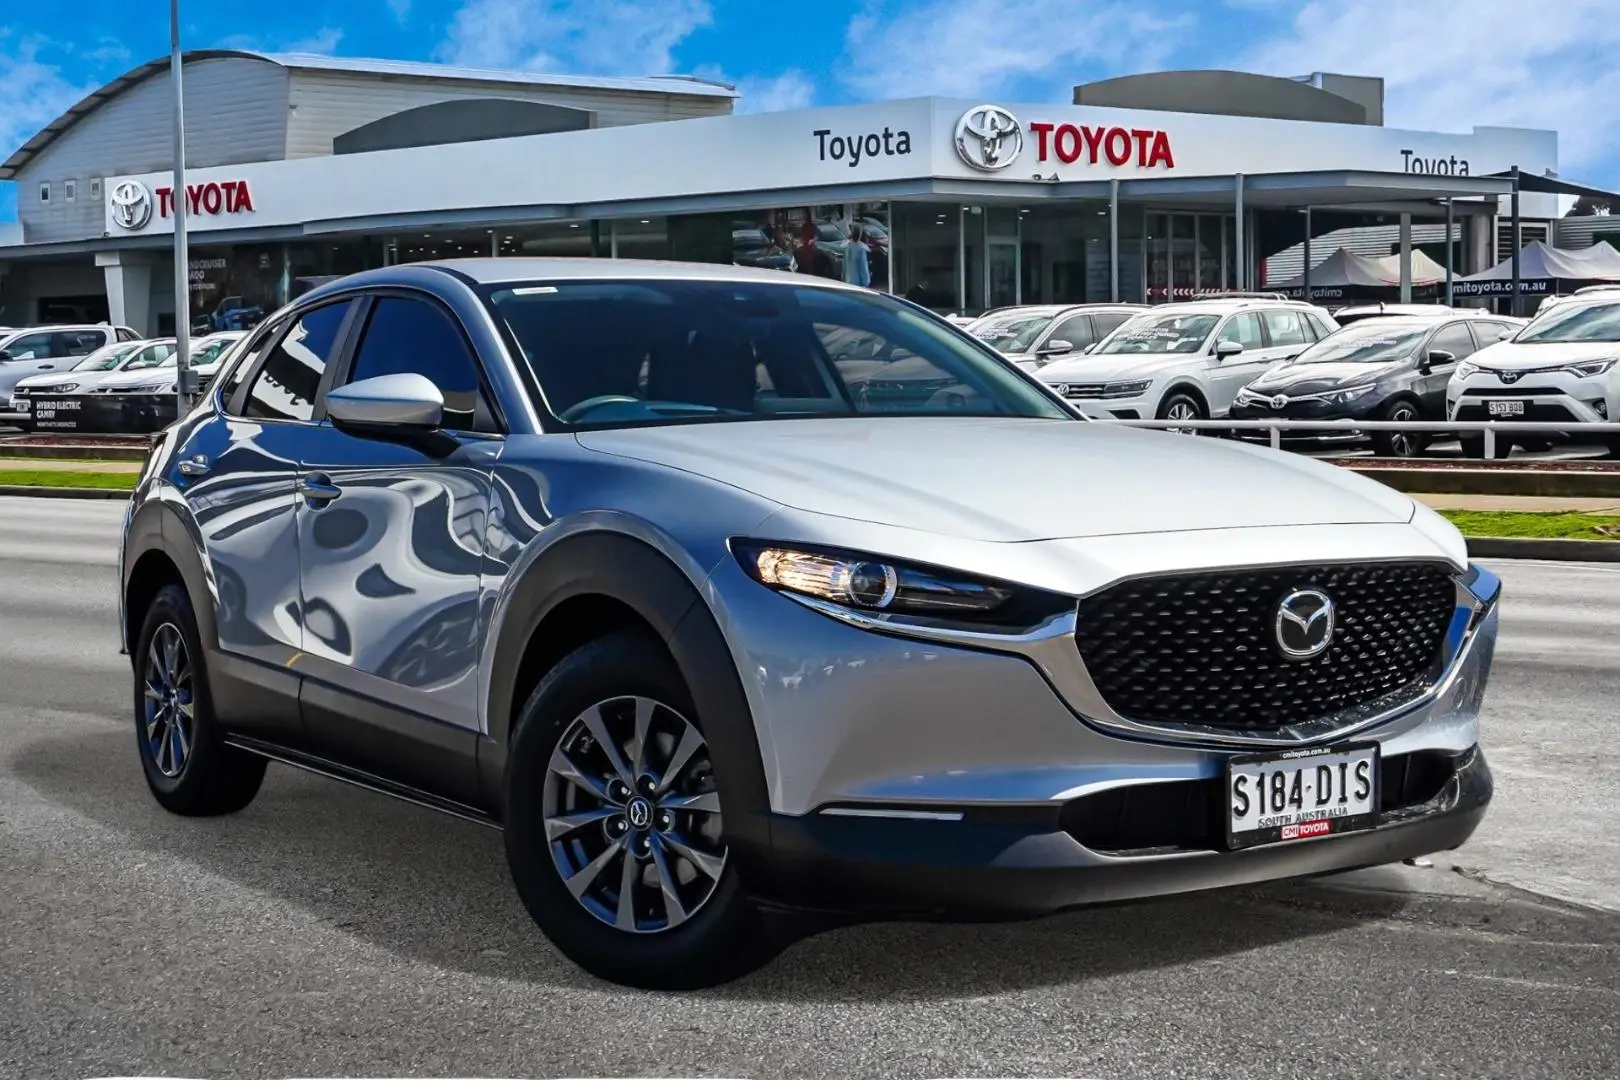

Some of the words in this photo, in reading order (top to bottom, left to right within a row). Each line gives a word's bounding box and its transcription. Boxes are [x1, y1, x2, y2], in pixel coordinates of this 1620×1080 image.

[813, 126, 911, 168] Toyota
[1030, 122, 1174, 168] TOYOTA
[1282, 747, 1331, 760] cmitoyota.com.au
[1258, 814, 1292, 828] SOUTH
[1295, 807, 1348, 824] AUSTRALIA
[1300, 822, 1330, 835] TOYOTA
